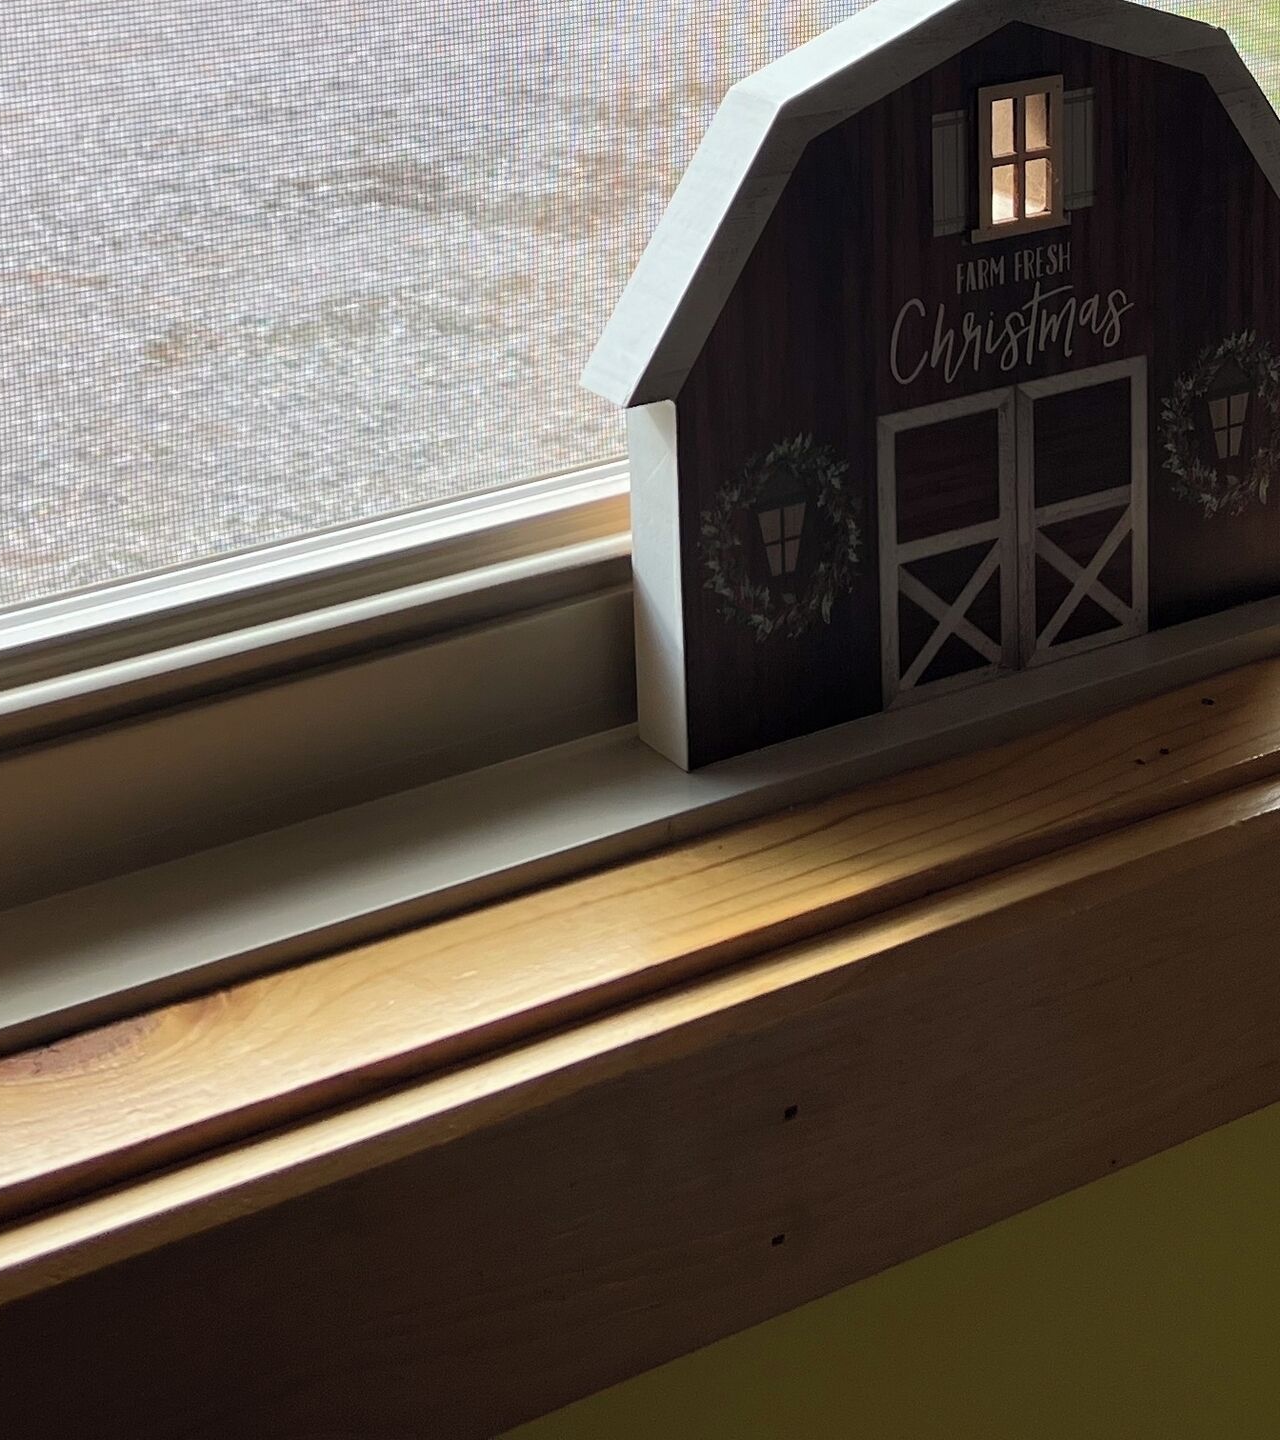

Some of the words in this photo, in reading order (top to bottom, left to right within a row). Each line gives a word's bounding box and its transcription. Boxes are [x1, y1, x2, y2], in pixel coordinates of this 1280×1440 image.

[956, 256, 1006, 295] FARM
[1014, 241, 1072, 283] FRESH
[890, 280, 1135, 385] Christmas
